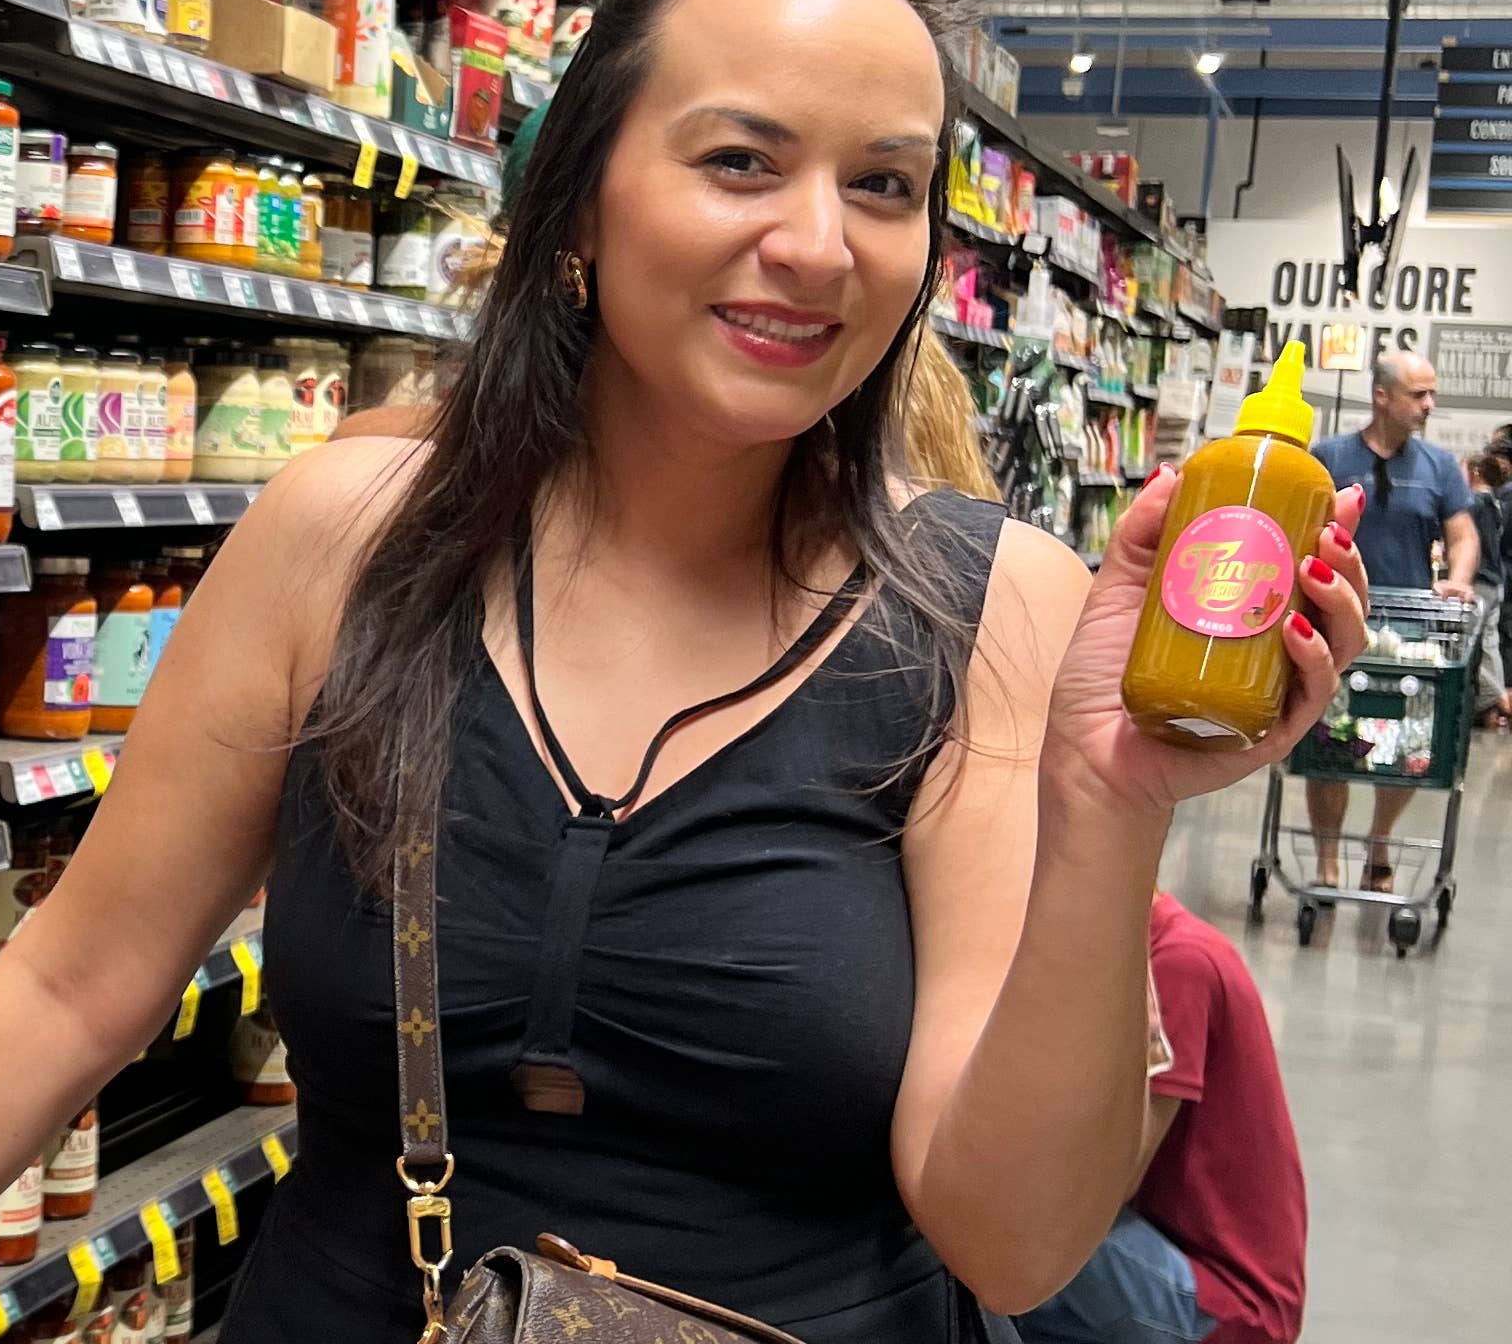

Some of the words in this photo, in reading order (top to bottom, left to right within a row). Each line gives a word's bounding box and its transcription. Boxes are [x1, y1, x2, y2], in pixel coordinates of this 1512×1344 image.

[1368, 264, 1477, 313] CORE
[1178, 540, 1281, 612] Tango
[1196, 617, 1234, 633] MANGO
